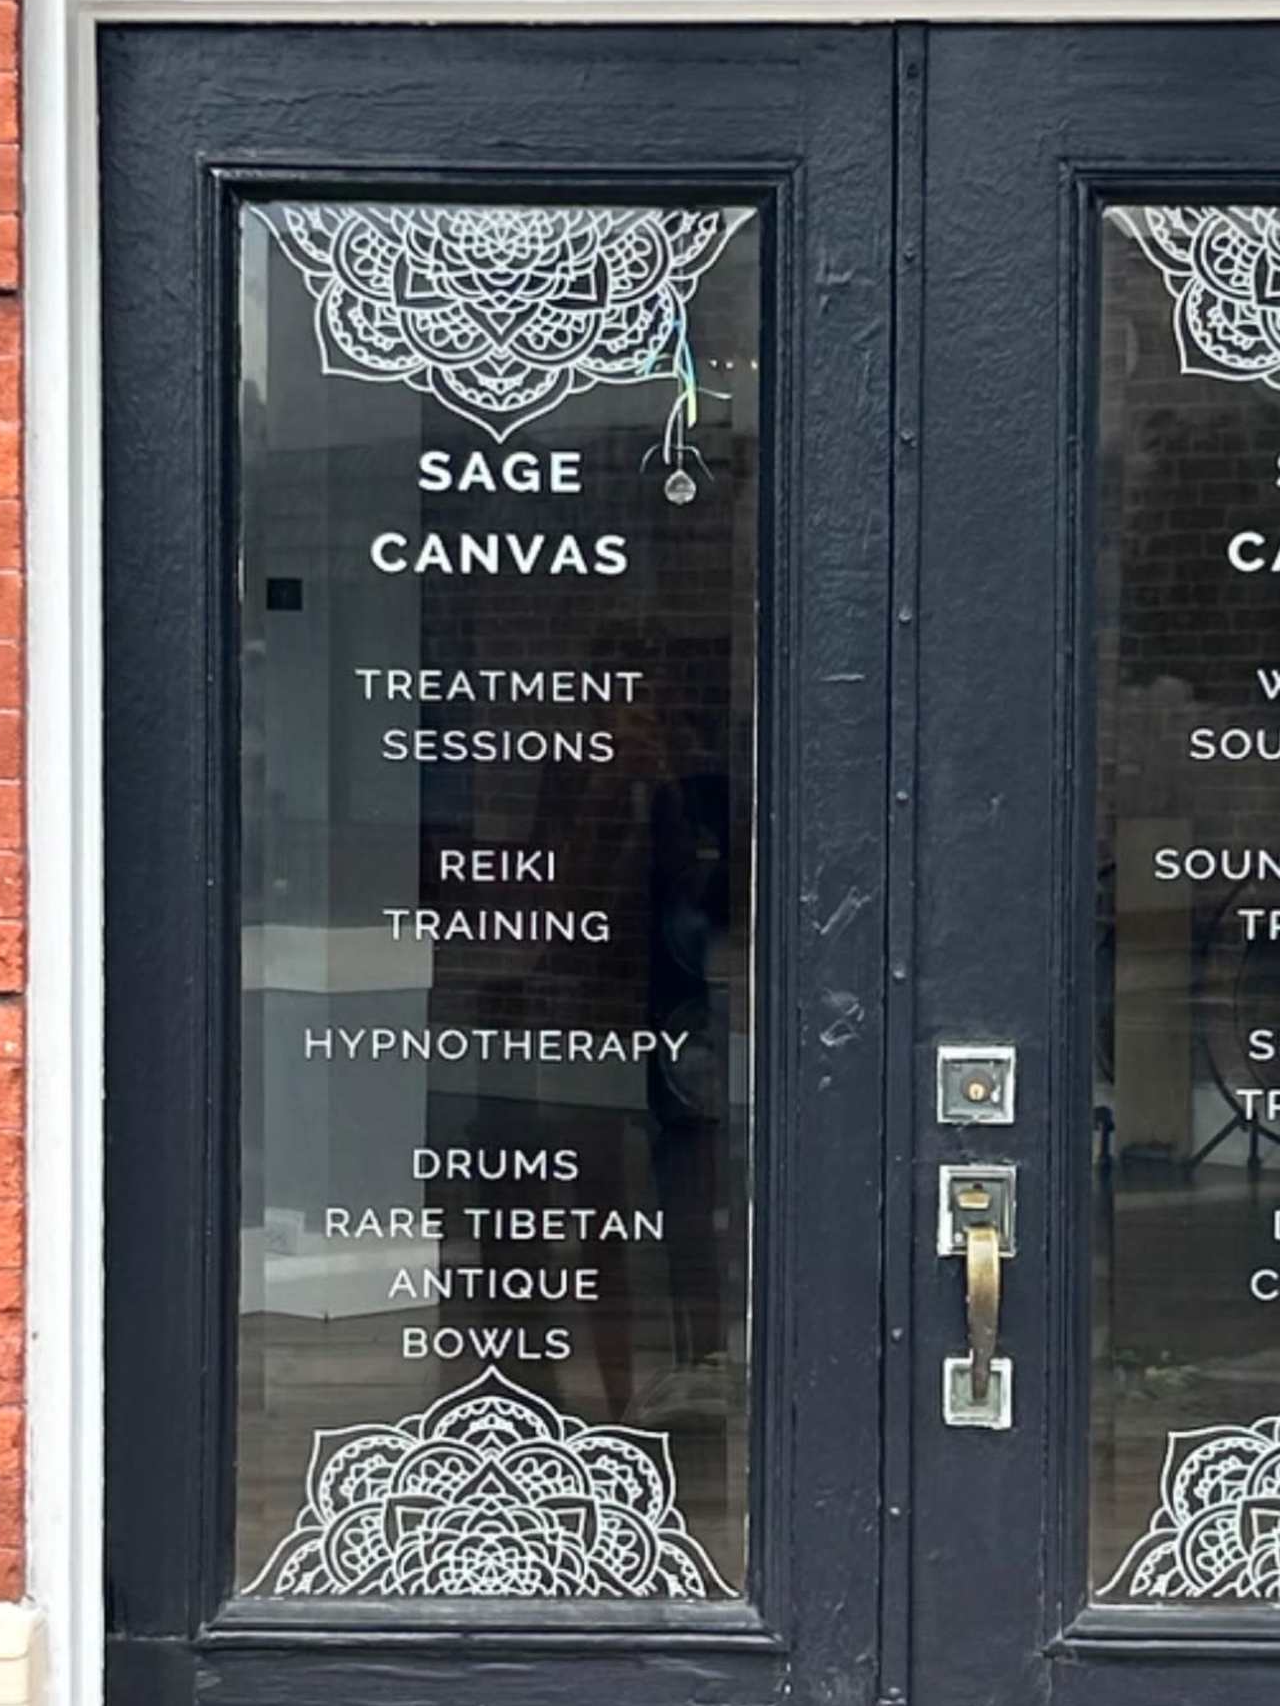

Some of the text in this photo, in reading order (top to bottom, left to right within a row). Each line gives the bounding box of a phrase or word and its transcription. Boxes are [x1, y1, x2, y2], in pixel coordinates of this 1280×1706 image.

[418, 450, 582, 493] SAGE
[370, 532, 627, 575] CANVAS
[355, 669, 643, 703] TREATMENT
[383, 729, 614, 763] SESSIONS
[440, 849, 555, 882] REIKI
[383, 909, 609, 943] TRAINING
[306, 1028, 689, 1062] HYPNOTHERAPY
[413, 1148, 579, 1181] DRUMS
[326, 1207, 664, 1241] RARE TIBETAN
[390, 1268, 599, 1300] ANTIQUE
[403, 1327, 571, 1360] BOWLS
